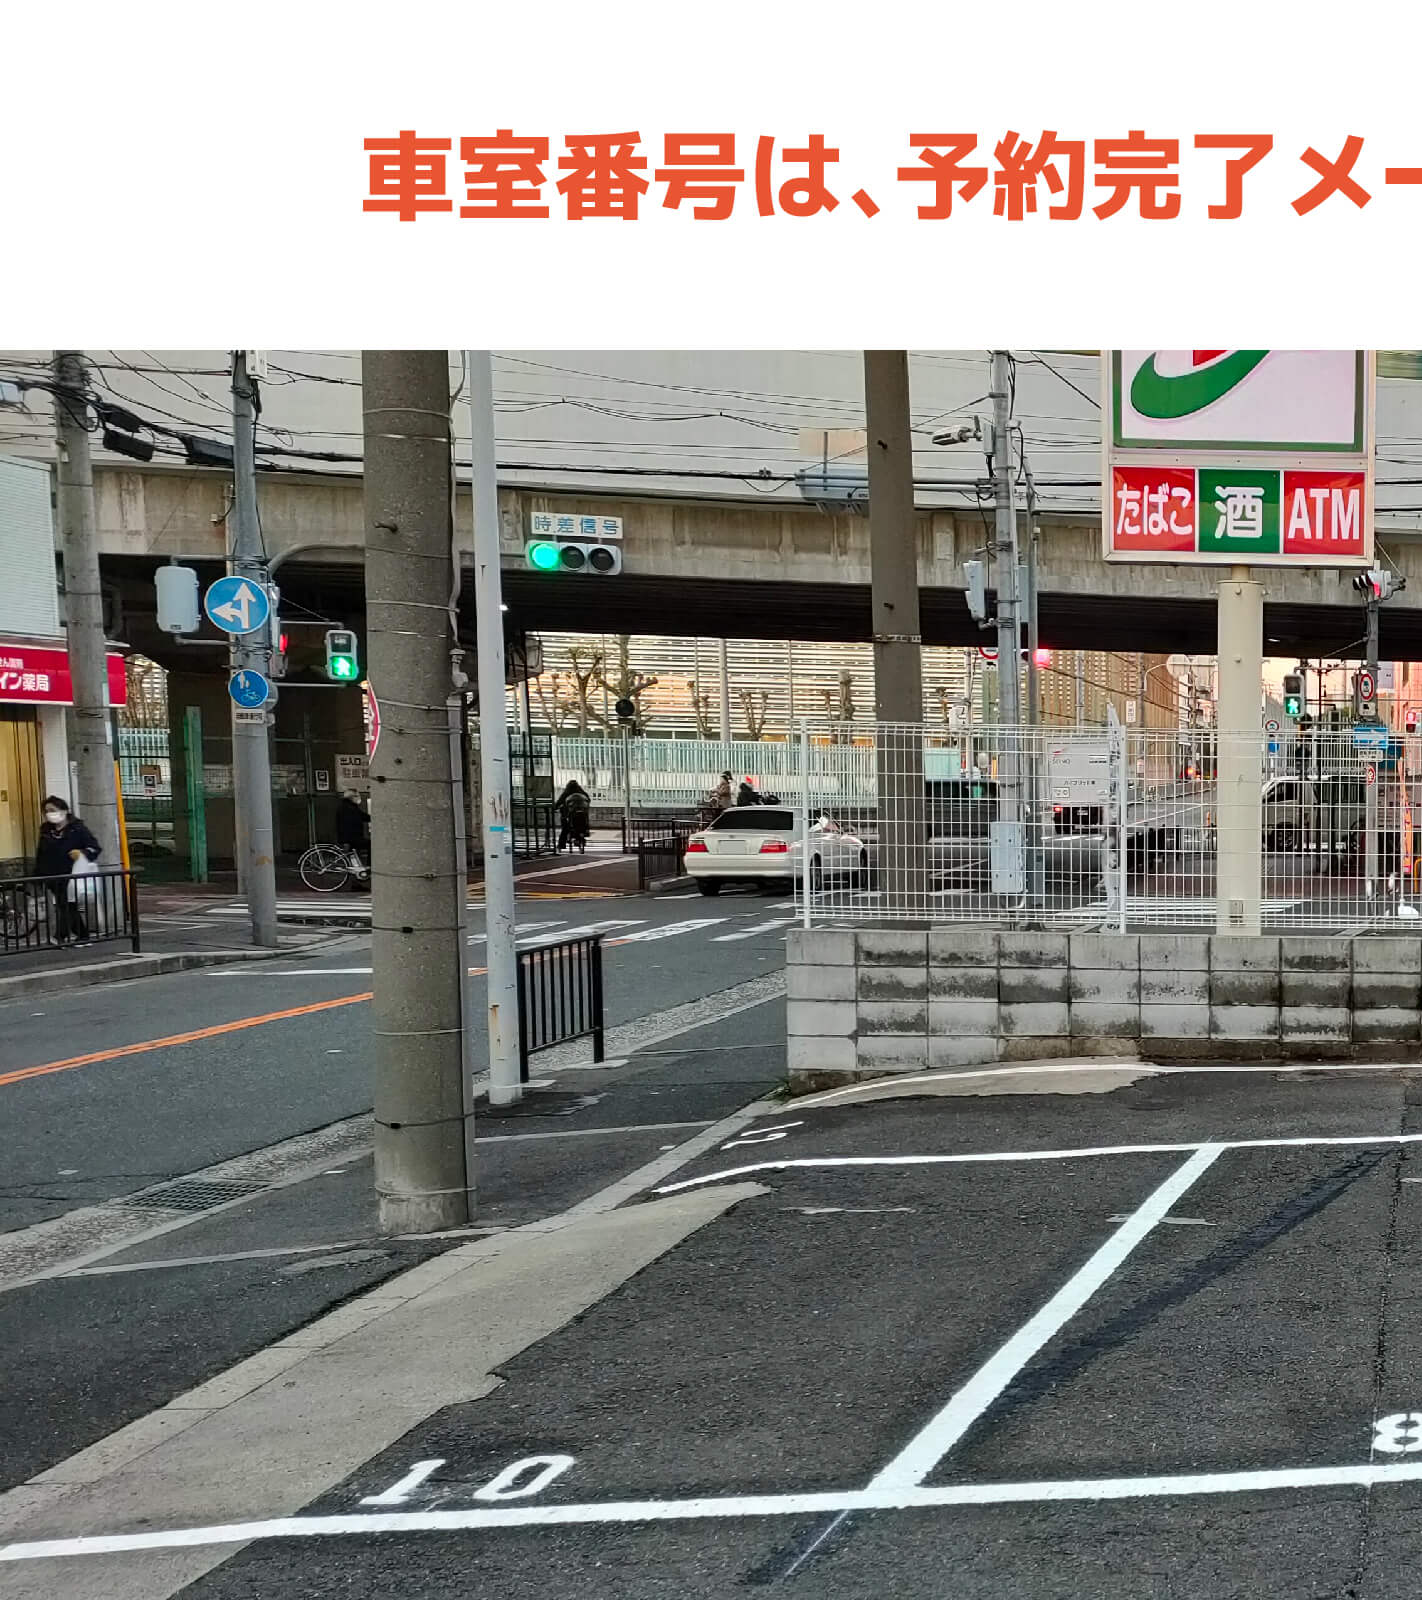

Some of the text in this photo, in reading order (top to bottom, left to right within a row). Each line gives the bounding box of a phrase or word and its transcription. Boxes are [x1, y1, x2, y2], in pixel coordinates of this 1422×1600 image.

[534, 515, 620, 535] 時差信号
[1116, 482, 1193, 536] たばこ
[1214, 485, 1265, 539] 酒
[1287, 487, 1361, 541] ATM
[359, 1454, 576, 1505] 10
